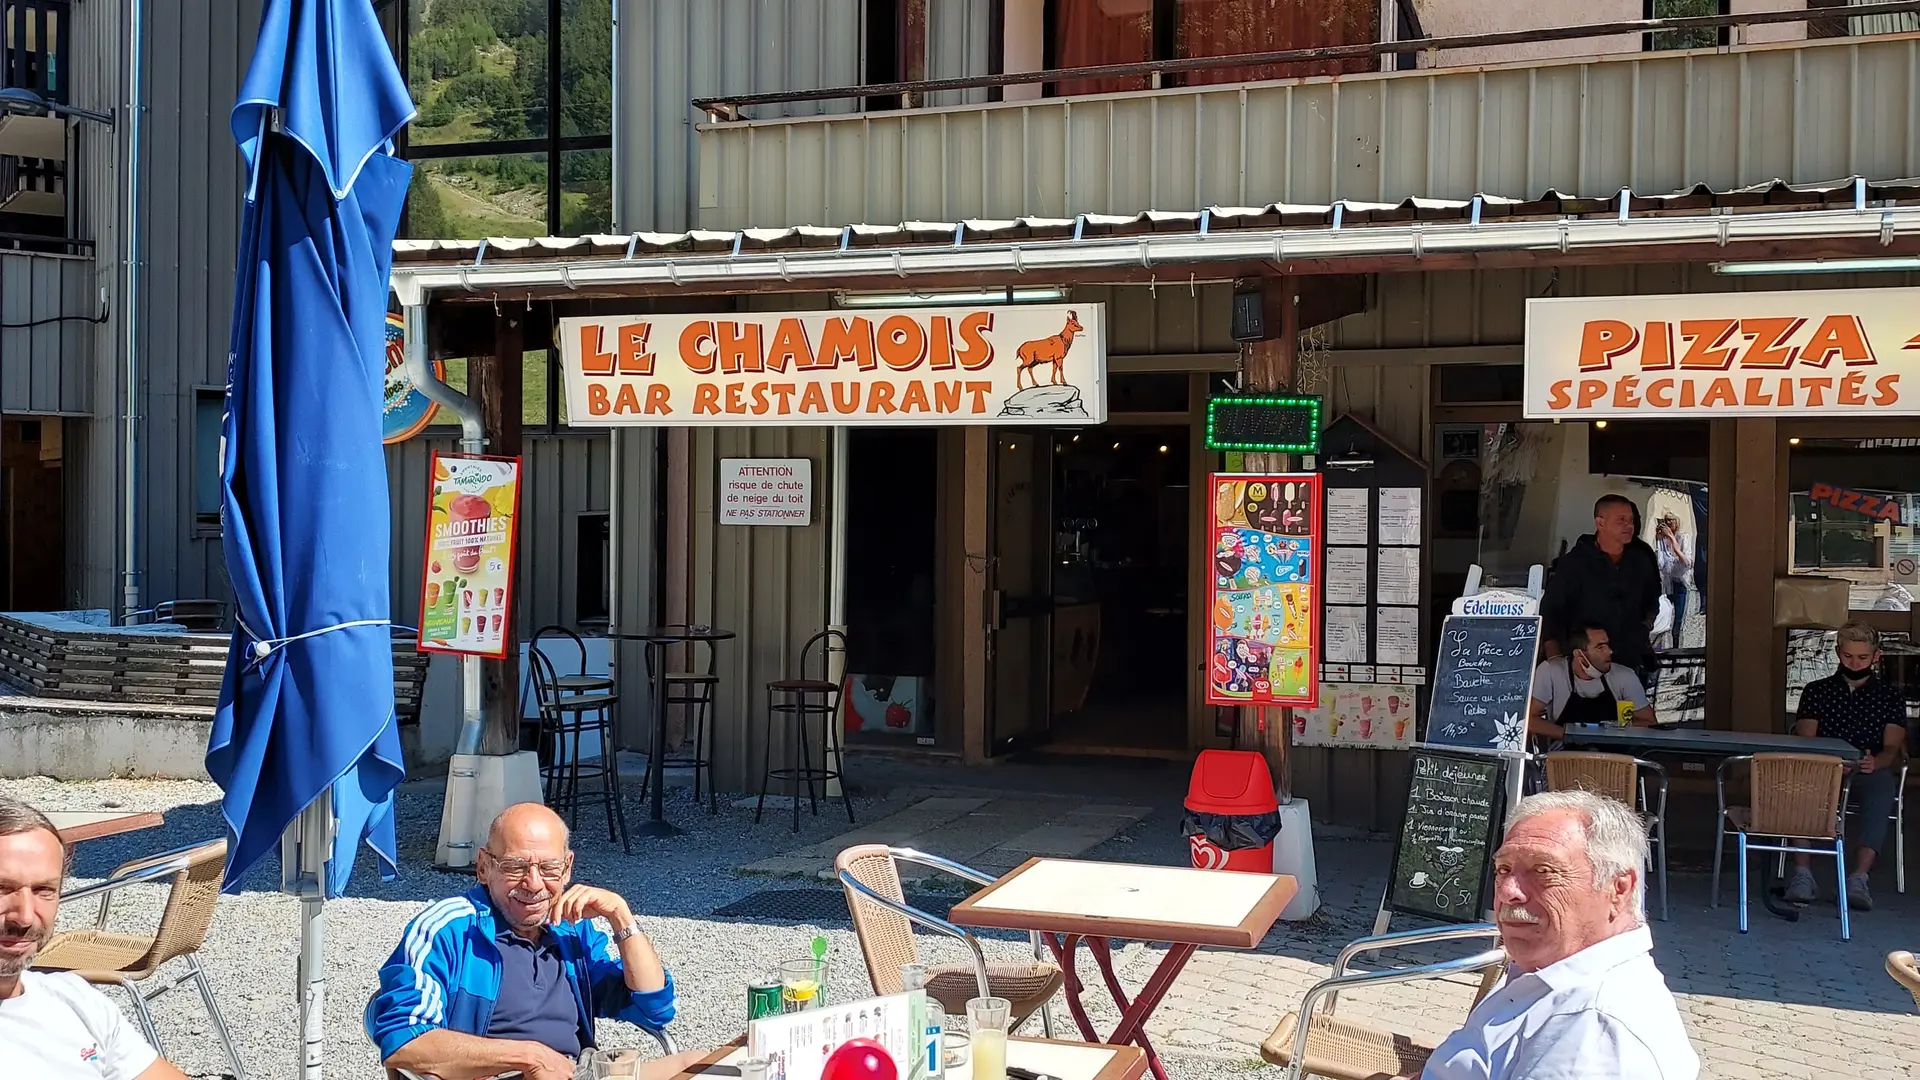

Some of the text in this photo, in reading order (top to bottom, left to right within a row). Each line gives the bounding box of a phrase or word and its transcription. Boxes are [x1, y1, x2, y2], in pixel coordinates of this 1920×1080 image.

[580, 311, 995, 377] LE CHAMOIS
[1577, 314, 1878, 373] PIZZA
[587, 380, 993, 416] BAR RESTAURANT
[1546, 370, 1901, 410] SPÉCIALITÉS
[738, 466, 793, 476] ATTENTION
[728, 480, 804, 491] risque de chute
[727, 494, 804, 504] de neige du toit
[1810, 483, 1900, 525] PIZZA
[725, 509, 805, 518] NE PAS STATIONNER
[435, 517, 506, 538] SMOOTHIES
[1463, 599, 1525, 616] Edelweiss
[1415, 758, 1439, 776] Petit
[1410, 785, 1490, 807] 1 Boisson chaude
